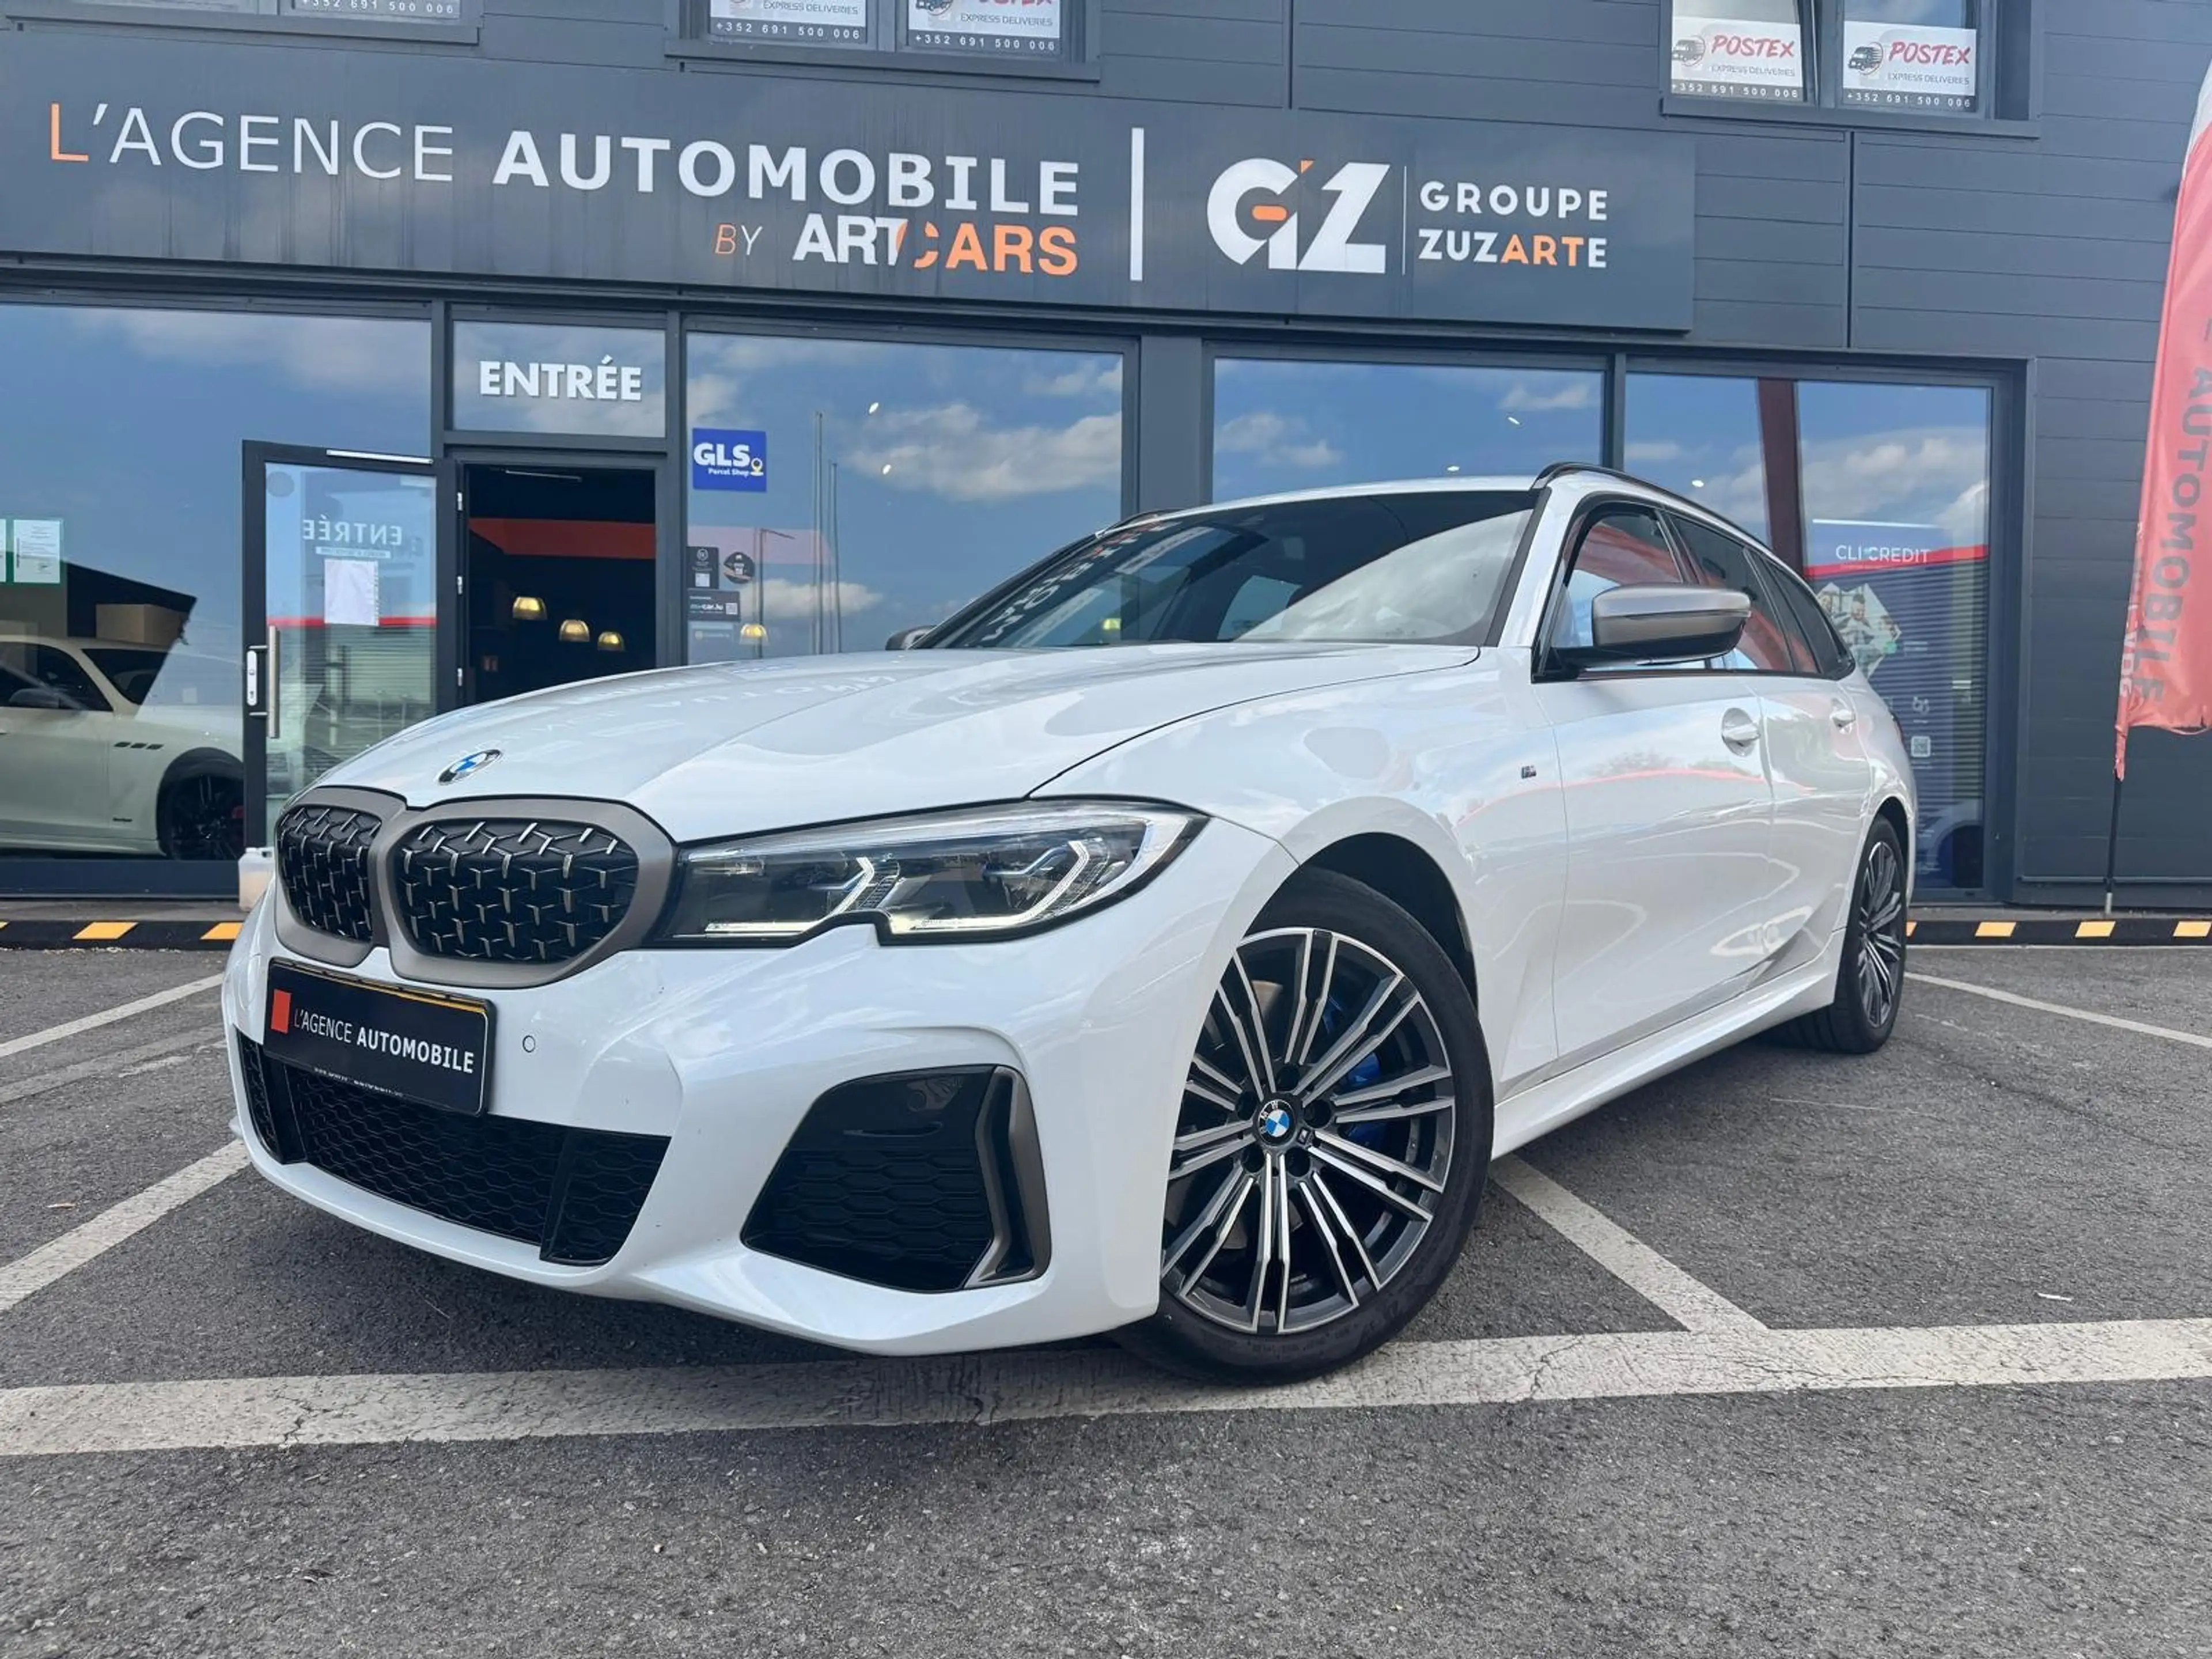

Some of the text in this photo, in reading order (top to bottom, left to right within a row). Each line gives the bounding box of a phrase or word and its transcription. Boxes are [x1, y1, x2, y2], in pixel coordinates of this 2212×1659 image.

[351, 0, 377, 9] 691
[389, 2, 416, 12] 500
[426, 3, 453, 13] 006
[763, 1, 858, 15] EXPRESS DELIVERIES
[960, 13, 1053, 26] EXPRESS DELIVERIES
[717, 22, 860, 40] +352 691 500 006
[916, 34, 1055, 51] +352 691 500 006
[1711, 35, 1795, 58] POSTEX
[1888, 41, 1971, 66] POSTEX
[1743, 87, 1767, 96] 500
[1775, 89, 1798, 99] 006
[1847, 92, 1971, 108] +352 691 500 006
[50, 103, 1079, 217] L'AGENCE AUTOMOBILE
[1419, 180, 1608, 221] GROUPE
[715, 223, 762, 255] BY
[1418, 228, 1608, 269] ZUZARTE
[479, 355, 642, 402] ENTRÉE
[694, 442, 751, 467] GLS
[708, 467, 749, 478] Parcel Shop
[1868, 547, 1931, 563] CREDIT
[294, 1009, 475, 1074] L'AGENCE AUTOMOBILE
